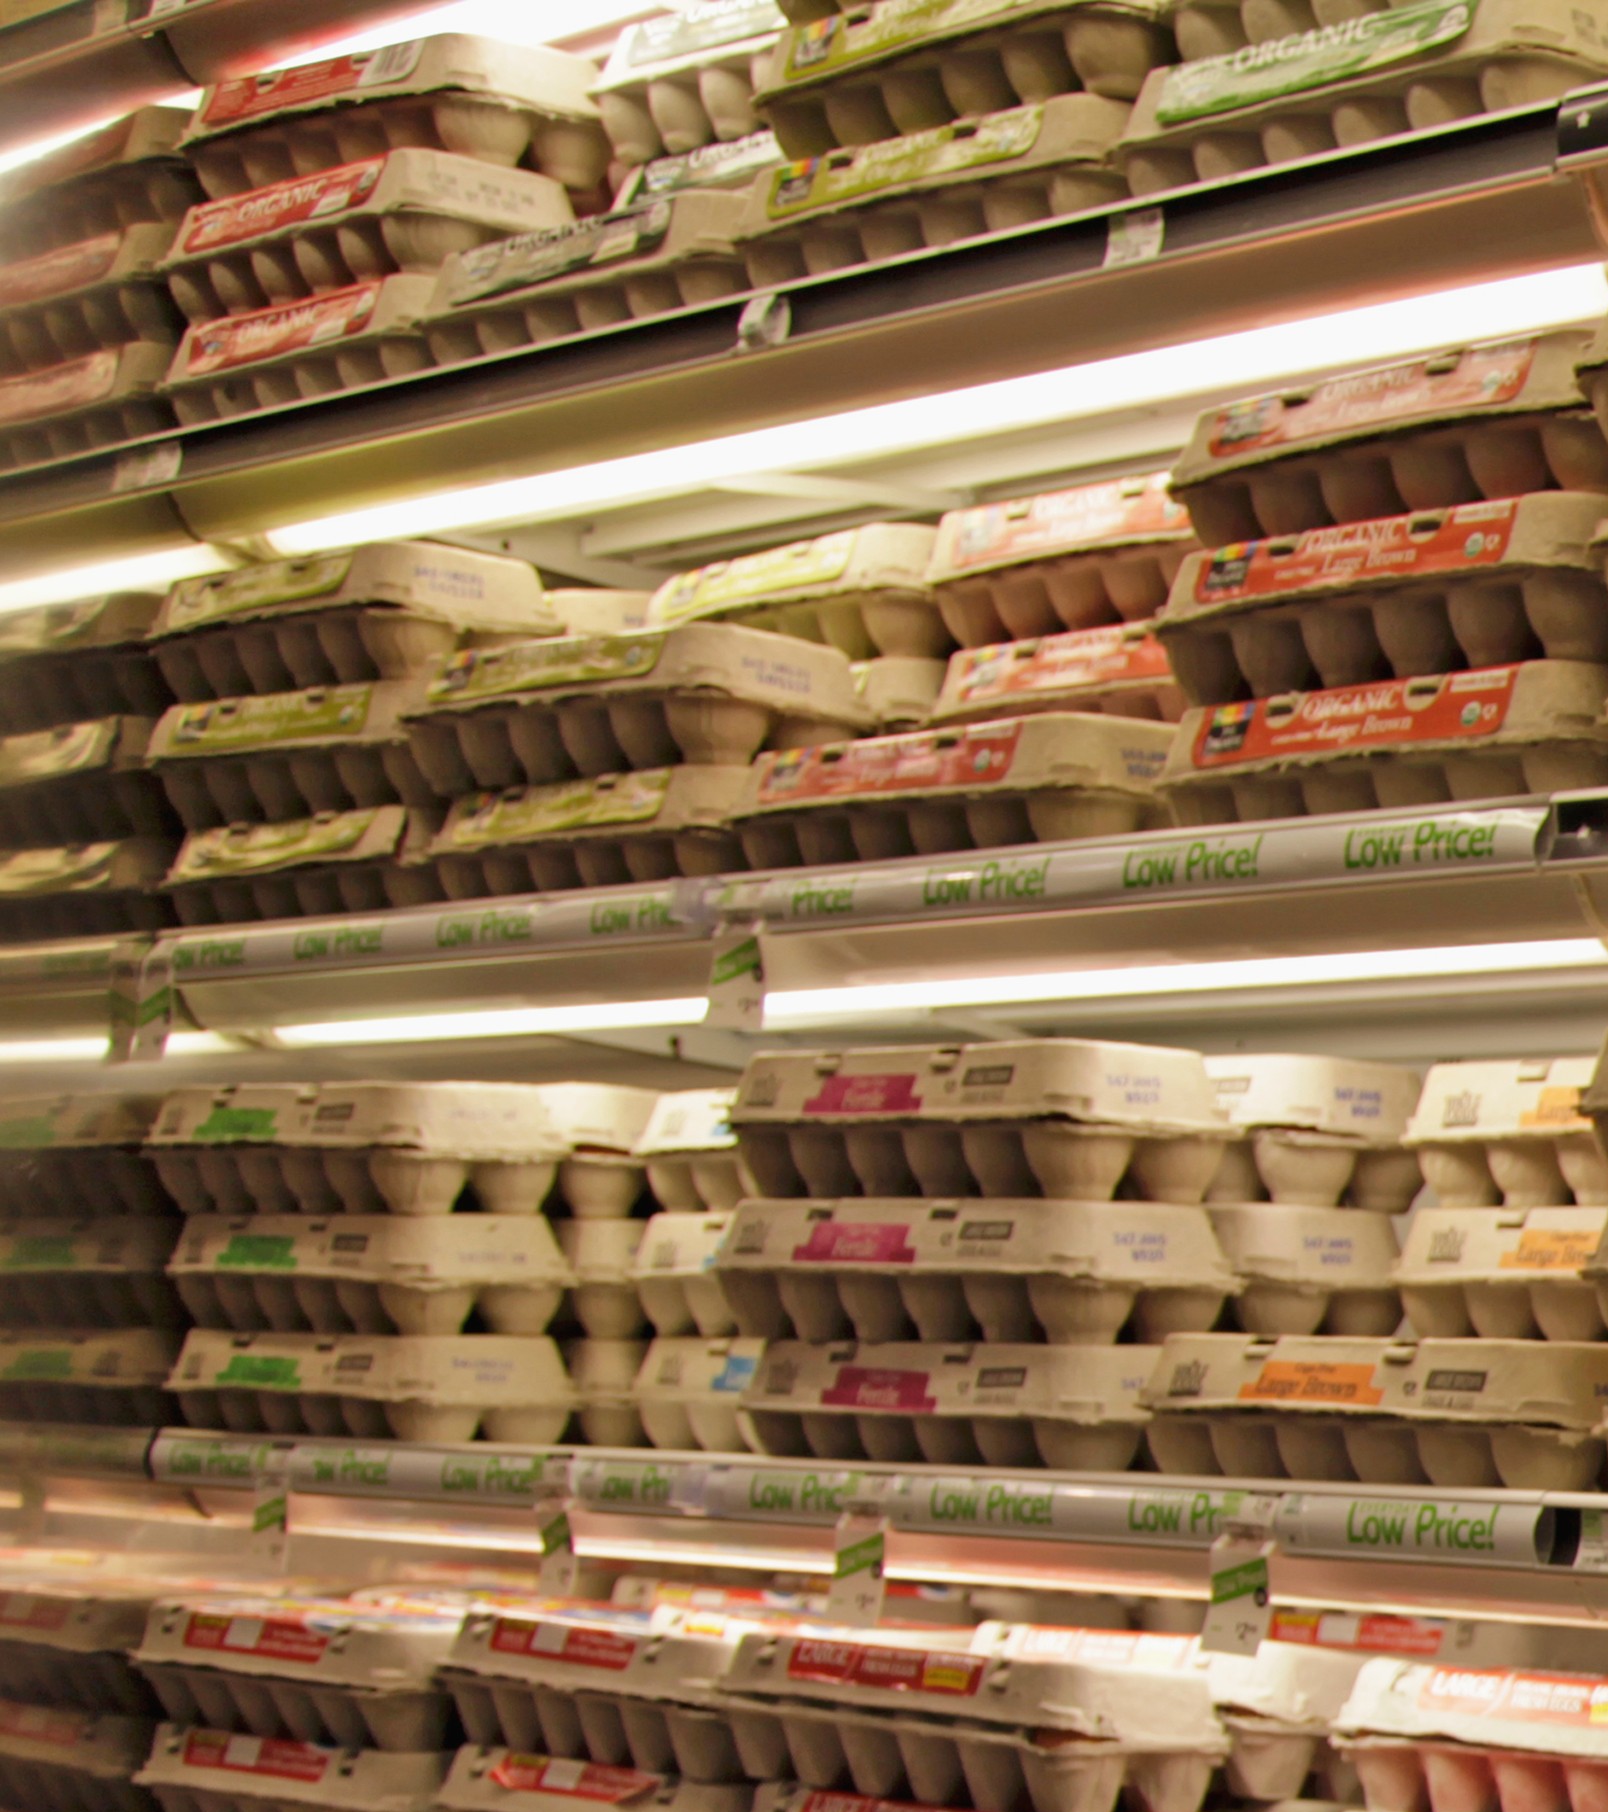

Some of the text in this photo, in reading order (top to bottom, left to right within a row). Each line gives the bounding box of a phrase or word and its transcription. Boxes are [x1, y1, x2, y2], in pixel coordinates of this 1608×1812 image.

[1345, 822, 1497, 869] Low Price!
[922, 857, 1050, 906] Low Price!
[930, 1485, 1054, 1527] Low Price!
[1347, 1501, 1497, 1551] Low Price!
